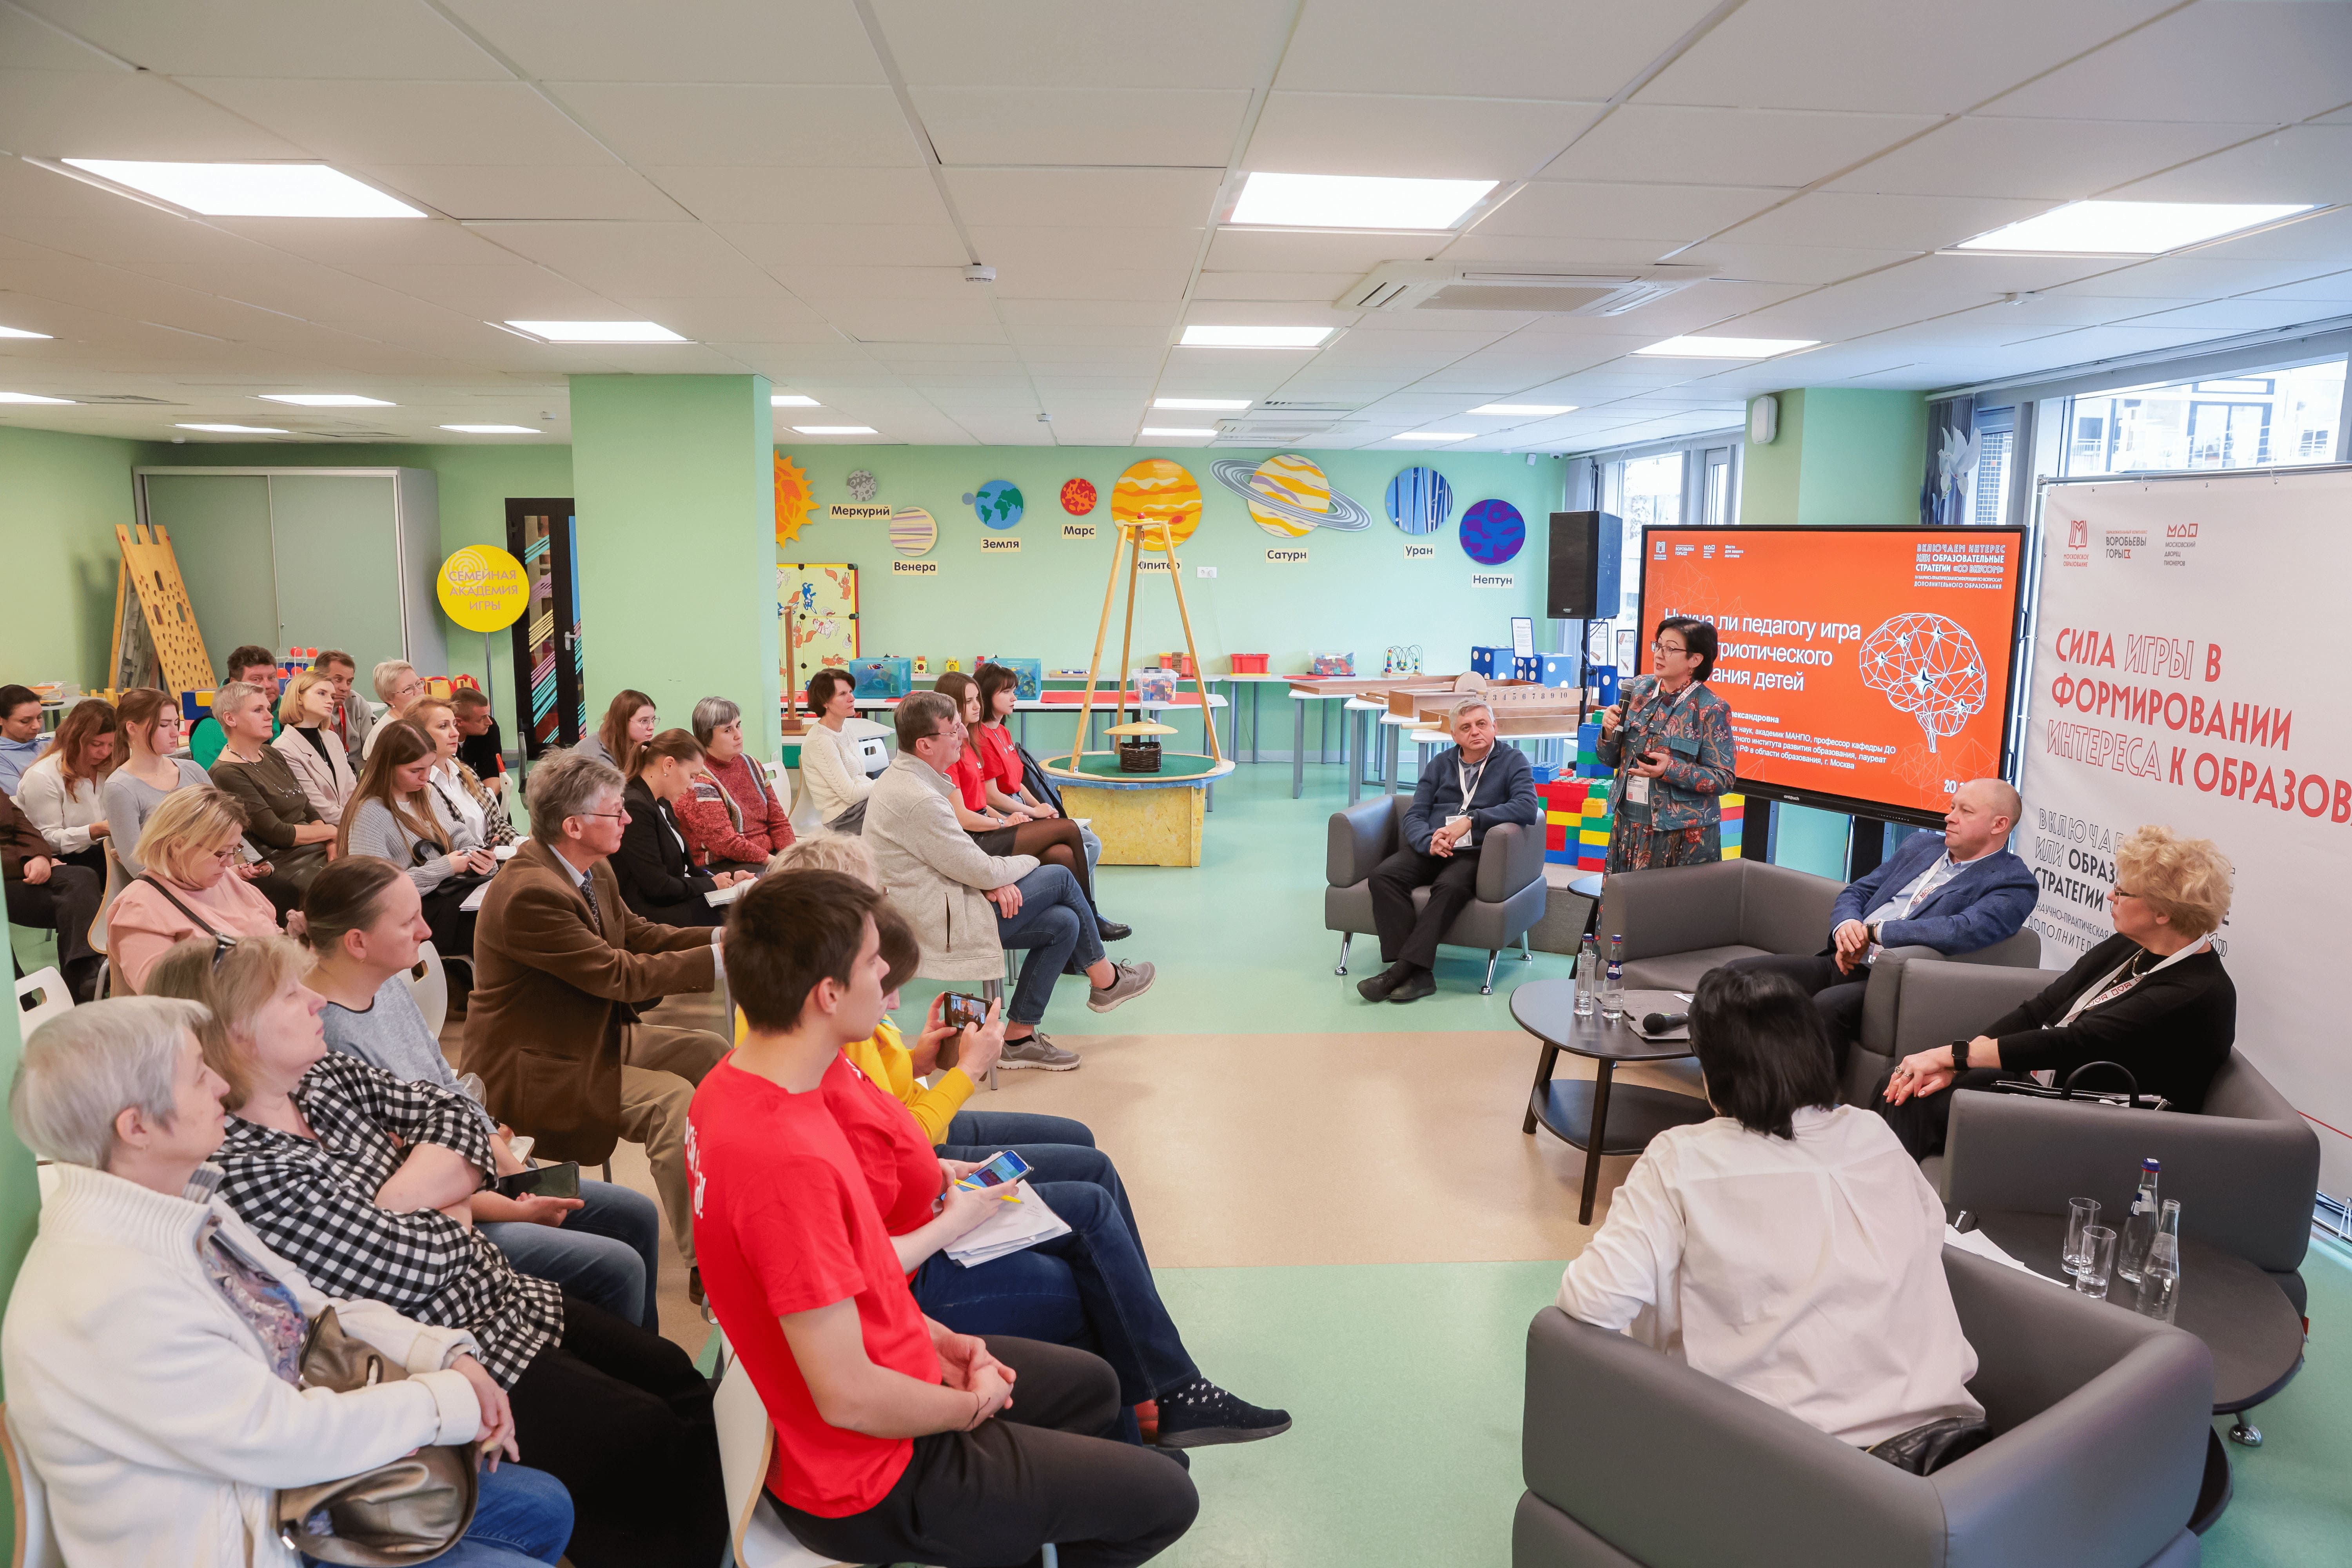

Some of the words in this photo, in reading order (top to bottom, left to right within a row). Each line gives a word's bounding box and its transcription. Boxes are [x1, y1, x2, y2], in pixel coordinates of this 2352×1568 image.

[831, 506, 890, 517] Меркурий
[1063, 526, 1095, 537] Марс
[982, 539, 1019, 548] Земля
[2106, 536, 2147, 546] ВОРОБЬЕВЫ
[1405, 545, 1433, 557] Уран
[1917, 544, 1965, 553] ВКЛЮЧАЕМ
[1969, 544, 2006, 553] ИНТЕРЕС
[2106, 549, 2124, 559] ГОРЫ
[1267, 550, 1307, 561] Сатурн
[1916, 554, 1931, 562] ИЛИ
[1932, 554, 2004, 563] ОБРАЗОВАТЕЛЬНЫЕ
[894, 561, 936, 573] Венера
[1138, 561, 1180, 570] Юпите
[1916, 564, 1951, 572] СТРАТЕГИИ
[449, 568, 516, 581] СЕМЕЙНАЯ
[1473, 575, 1512, 586] Нептун
[450, 586, 518, 597] АКАДЕМИЯ
[470, 601, 501, 610] ИГРЫ
[1718, 616, 1738, 630] ли
[1743, 617, 1817, 642] педагогу
[1820, 623, 1861, 644] игра
[2056, 628, 2115, 669] СИЛА
[2124, 634, 2194, 680] ИГРЫ
[2205, 643, 2222, 682] В
[1707, 668, 1750, 685] ания
[1753, 671, 1805, 691] детей
[2052, 672, 2292, 751] ФОРМИРОВАНИИ
[1755, 729, 1784, 739] академик
[1785, 732, 1813, 743] МАНПО,
[1814, 737, 1850, 749] профессор
[1851, 742, 1883, 753] кафедры
[1884, 745, 1896, 755] ДО
[1752, 739, 1782, 748] института
[1783, 743, 1811, 753] развития
[1813, 746, 1857, 760] образования,
[1858, 754, 1886, 764] лауреат
[1755, 748, 1779, 757] области
[1781, 752, 1823, 766] образования,
[1830, 759, 1855, 769] Москва
[2047, 719, 2161, 781] ИНТЕРЕСА
[2169, 746, 2187, 786] К
[2193, 752, 2352, 826] ОБРАЗОВ
[2035, 837, 2064, 867] ИЛИ
[2033, 867, 2104, 912] СТРАТЕГИИ
[2036, 901, 2108, 940] НАУЧНО-ПРАКТИЧЕСКАЯ
[2028, 916, 2096, 953] ДОПОЛНИТЕЛ
